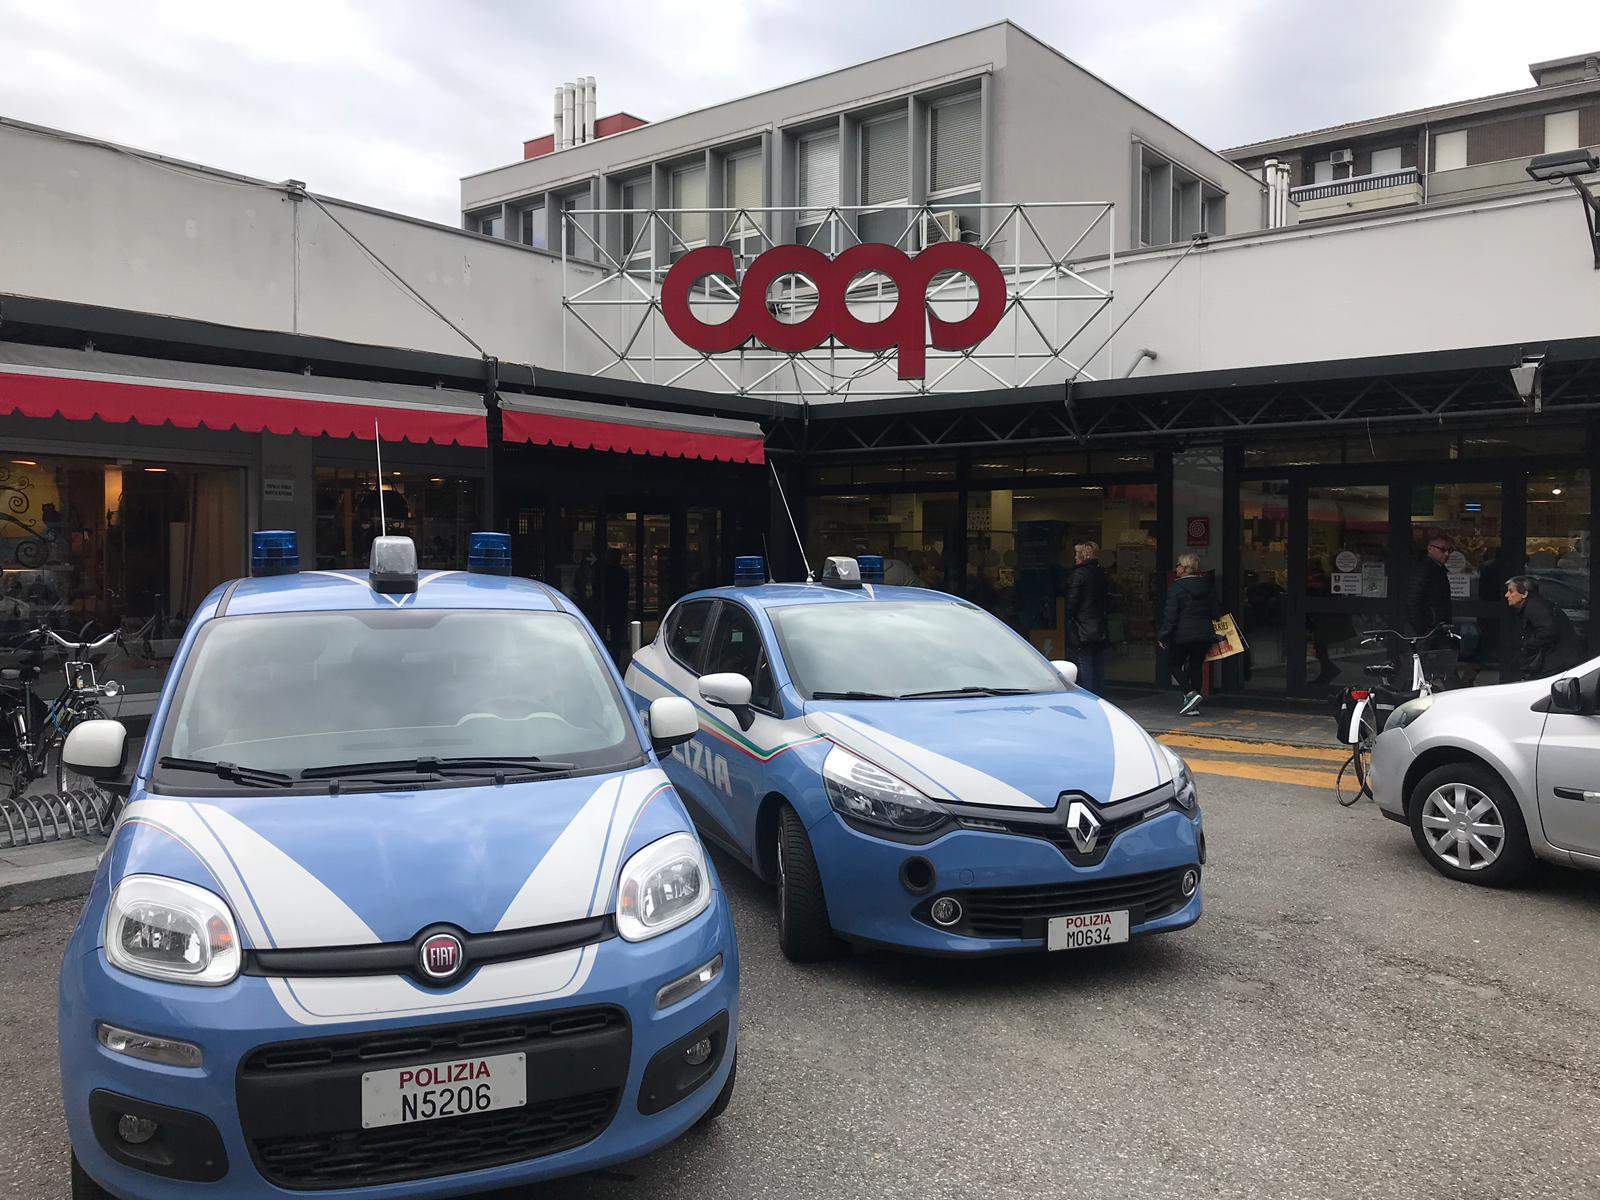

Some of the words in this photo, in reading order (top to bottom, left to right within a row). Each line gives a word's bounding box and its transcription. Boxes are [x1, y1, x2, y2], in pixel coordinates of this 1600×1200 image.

[661, 242, 1006, 380] coop
[671, 738, 733, 797] LIZIA
[1066, 914, 1111, 928] POLIZIA
[1067, 927, 1111, 947] M0634
[430, 946, 454, 967] FIAT
[399, 1060, 491, 1089] POLIZIA
[402, 1083, 491, 1121] N5206
